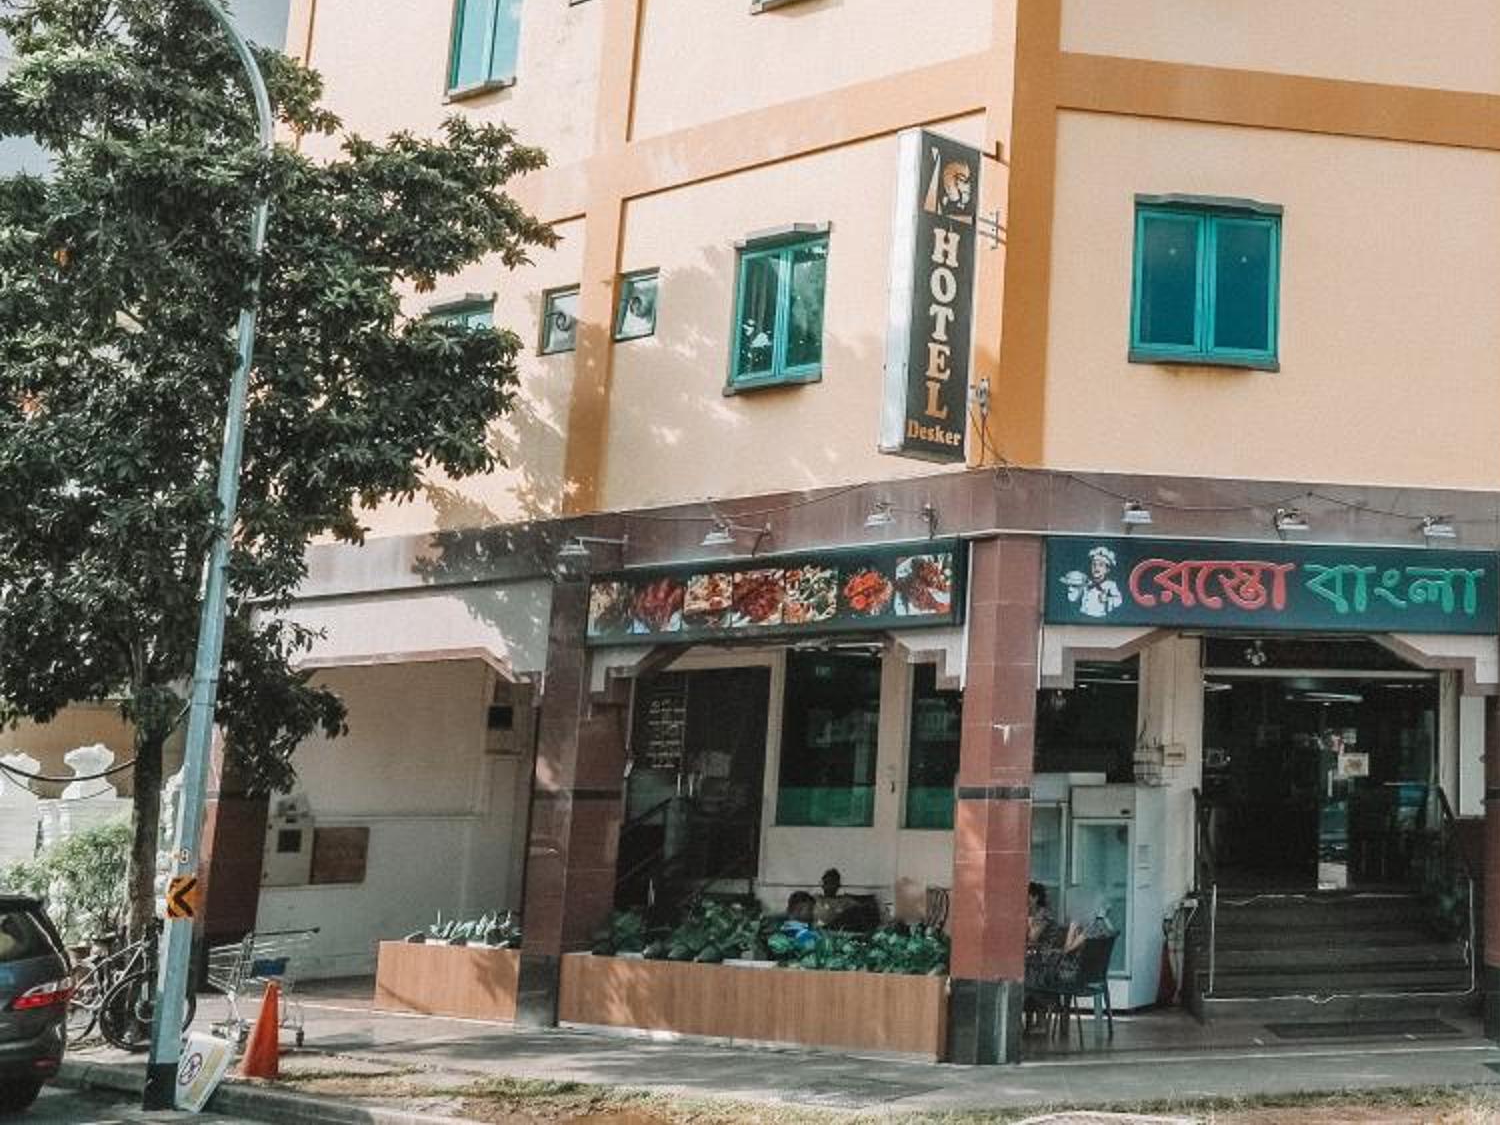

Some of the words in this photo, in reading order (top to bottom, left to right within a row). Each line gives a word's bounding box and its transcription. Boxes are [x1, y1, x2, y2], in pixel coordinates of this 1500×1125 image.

[924, 228, 960, 420] HOTEL
[907, 419, 962, 447] Desker
[1303, 564, 1485, 615] বাংলা
